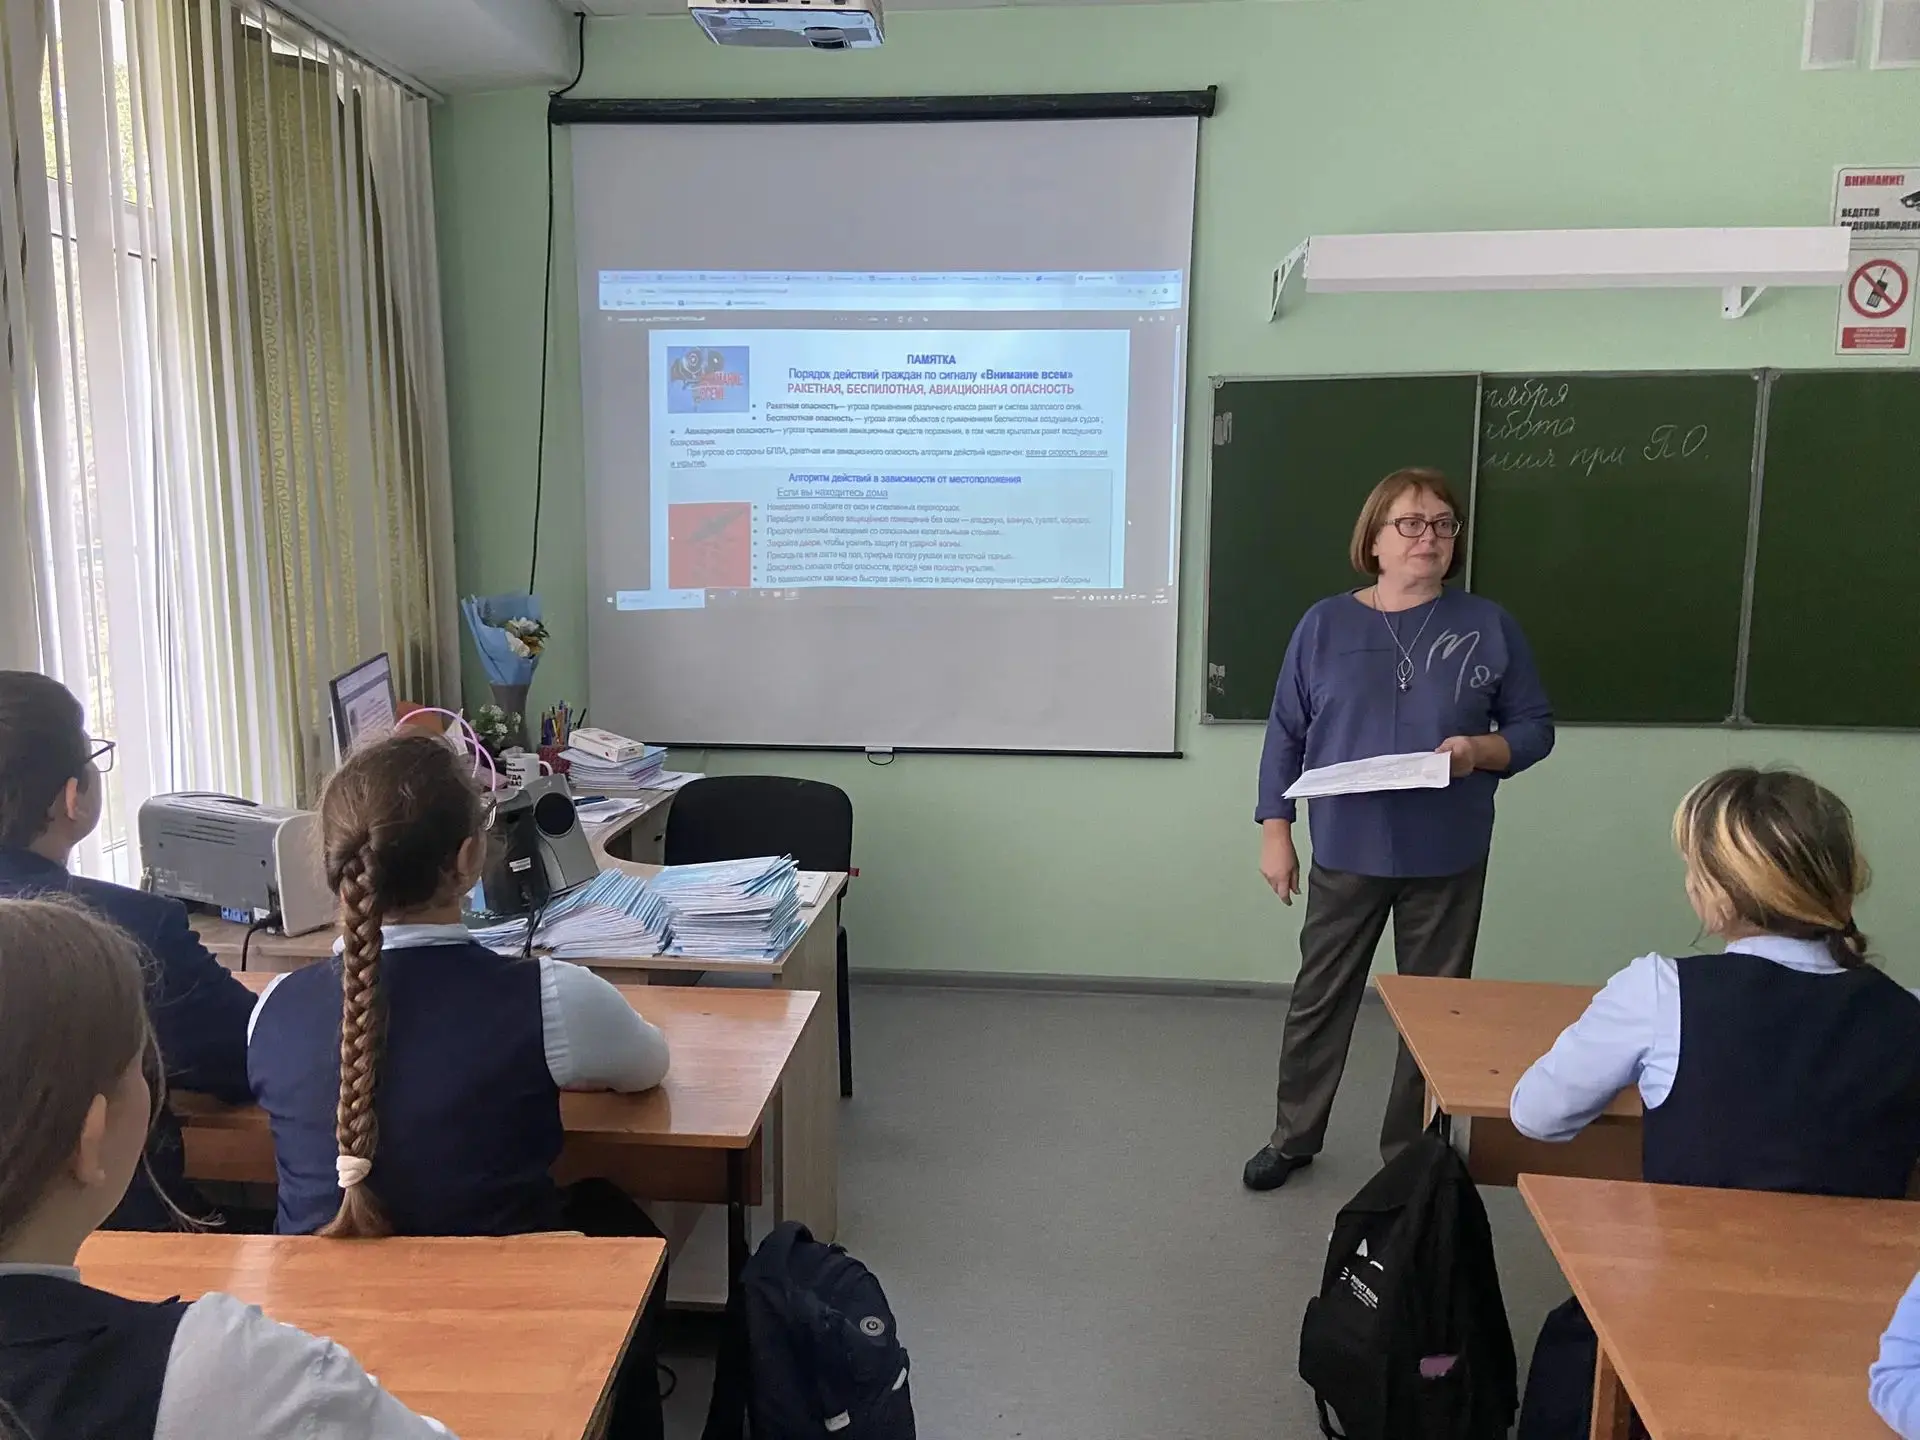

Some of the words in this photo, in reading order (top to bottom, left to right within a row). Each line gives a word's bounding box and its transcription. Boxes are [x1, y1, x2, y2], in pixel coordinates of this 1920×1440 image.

[1844, 175, 1905, 186] ВНИМАНИЕ!
[1841, 208, 1880, 218] ВЕДЕТСЯ
[907, 354, 956, 365] ПАМЯТКА
[788, 368, 832, 380] Порядок
[832, 370, 880, 380] действий
[882, 372, 922, 382] граждан
[924, 372, 937, 380] по
[939, 372, 977, 382] сигналу
[980, 370, 1039, 380] «Внимание
[1041, 372, 1074, 380] всем»
[788, 383, 844, 394] РАКЕТНАЯ,
[846, 383, 926, 394] БЕСПИЛОТНАЯ,
[929, 384, 1008, 396] АВИАЦИОННАЯ
[1010, 383, 1074, 394] ОПАСНОСТЬ
[1569, 446, 1626, 477] при
[788, 472, 829, 484] Алгоритм
[831, 474, 872, 484] действий
[777, 488, 800, 496] Если
[814, 490, 865, 498] находитесь
[866, 490, 889, 498] дома
